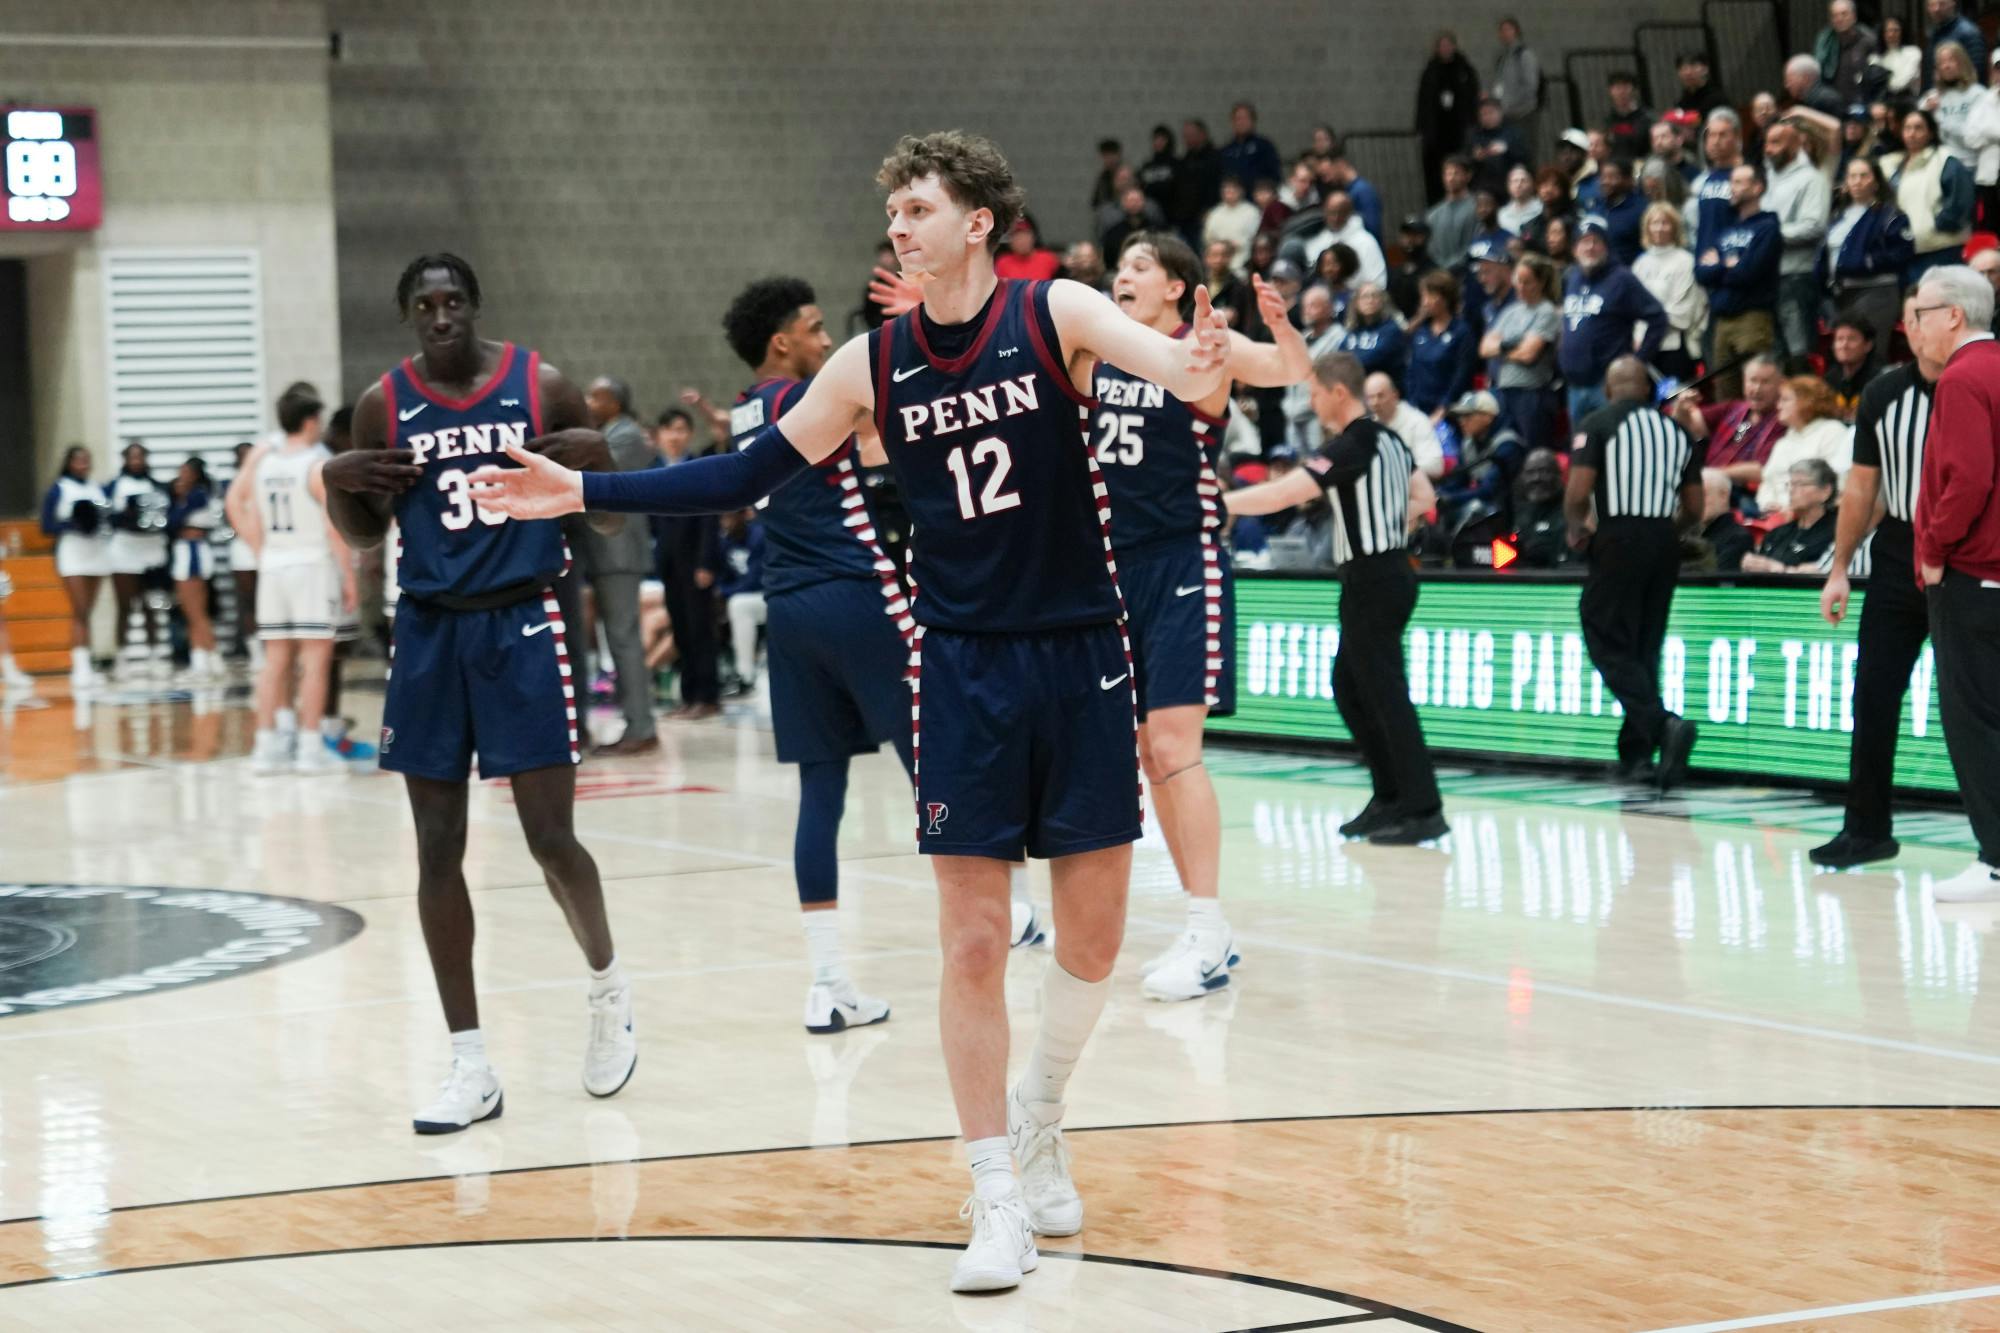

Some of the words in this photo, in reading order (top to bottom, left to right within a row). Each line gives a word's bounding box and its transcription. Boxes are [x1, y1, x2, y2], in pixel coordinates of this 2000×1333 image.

[899, 374, 1040, 442] PENN
[1096, 377, 1165, 409] PENN
[407, 422, 527, 465] PENN
[1096, 411, 1145, 466] 25
[947, 437, 1022, 520] 12
[1247, 621, 1341, 700] OFFIC
[1510, 630, 1686, 718] PARR
[1708, 637, 1757, 724] OF
[1780, 639, 1860, 733] THE
[927, 802, 949, 835] P
